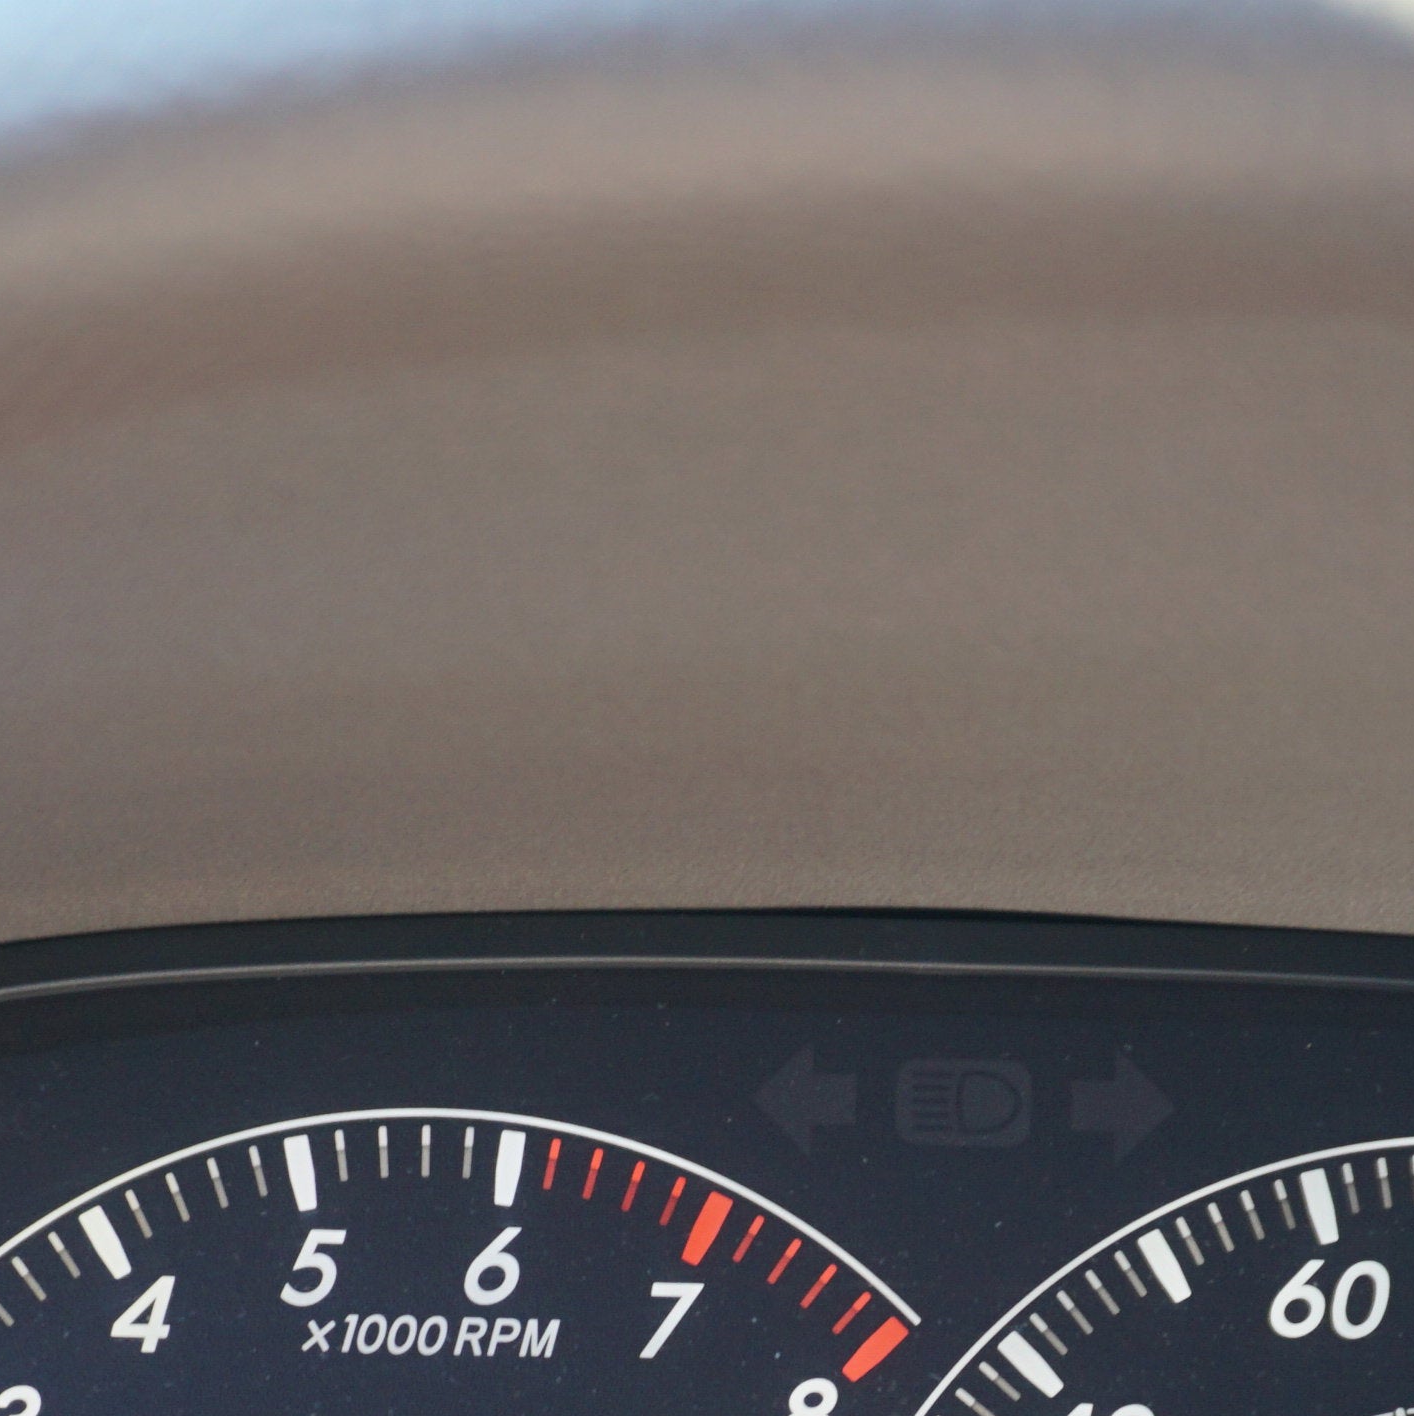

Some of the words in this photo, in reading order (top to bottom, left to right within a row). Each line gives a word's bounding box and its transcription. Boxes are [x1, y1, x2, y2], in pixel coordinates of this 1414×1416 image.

[280, 1228, 347, 1307] 5
[463, 1226, 522, 1306] 6
[1269, 1259, 1391, 1340] 60
[108, 1274, 176, 1355] 4
[453, 1316, 561, 1358] RPM
[639, 1281, 705, 1359] 7
